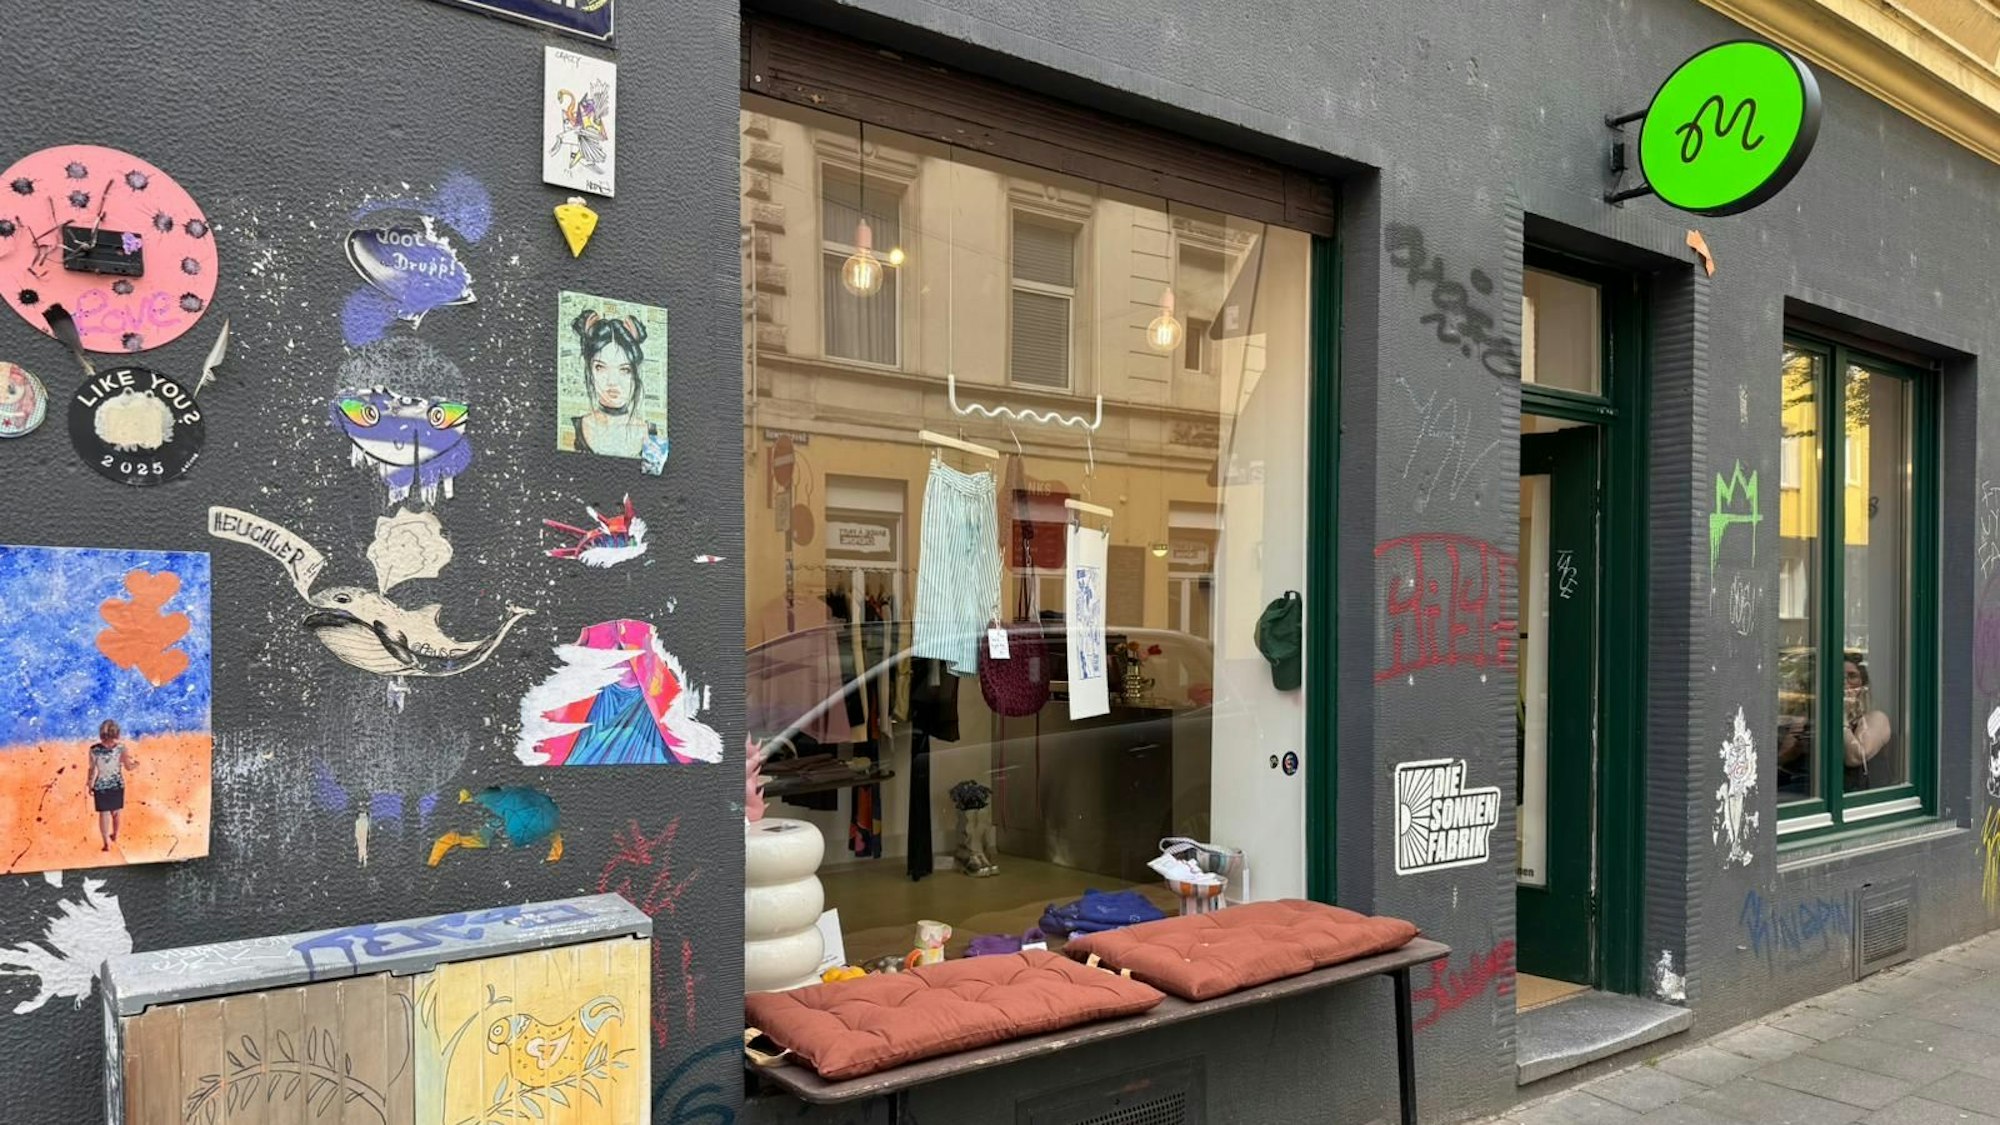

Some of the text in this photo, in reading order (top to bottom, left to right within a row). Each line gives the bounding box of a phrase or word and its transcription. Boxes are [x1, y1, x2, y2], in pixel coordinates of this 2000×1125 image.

[77, 370, 136, 408] LIKE
[101, 454, 164, 476] 2025
[213, 511, 305, 580] HEUCHLER
[1433, 765, 1462, 799] DIE
[1429, 793, 1497, 831] SONNEN
[1426, 826, 1488, 864] FABRIK
